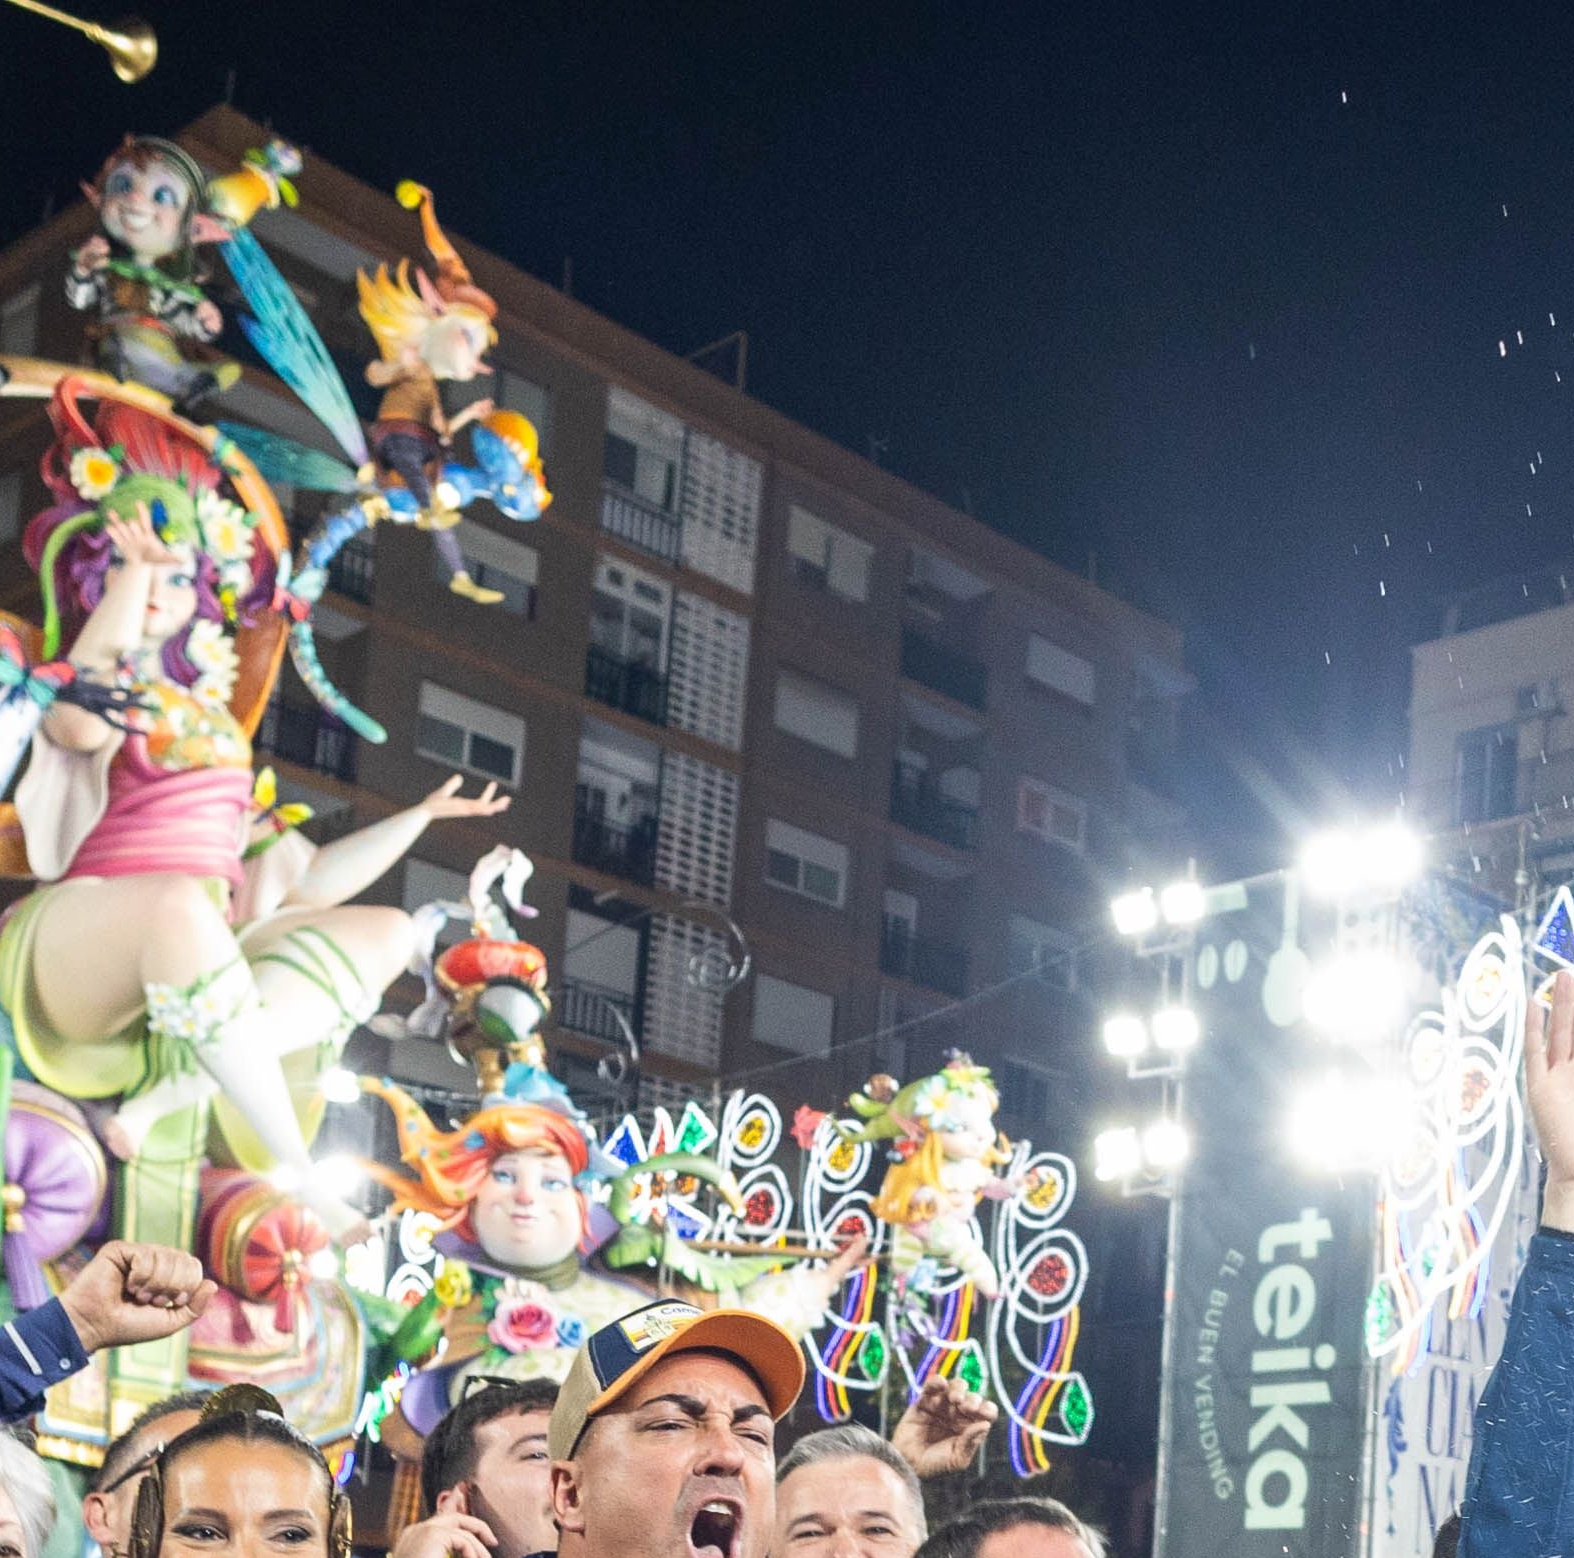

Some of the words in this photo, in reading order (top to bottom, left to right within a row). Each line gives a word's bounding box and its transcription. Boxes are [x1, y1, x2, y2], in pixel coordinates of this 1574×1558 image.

[1218, 1247, 1246, 1277] EL
[1196, 1288, 1229, 1365] BUEN
[1243, 1206, 1336, 1530] teika
[1194, 1373, 1235, 1501] VENDING
